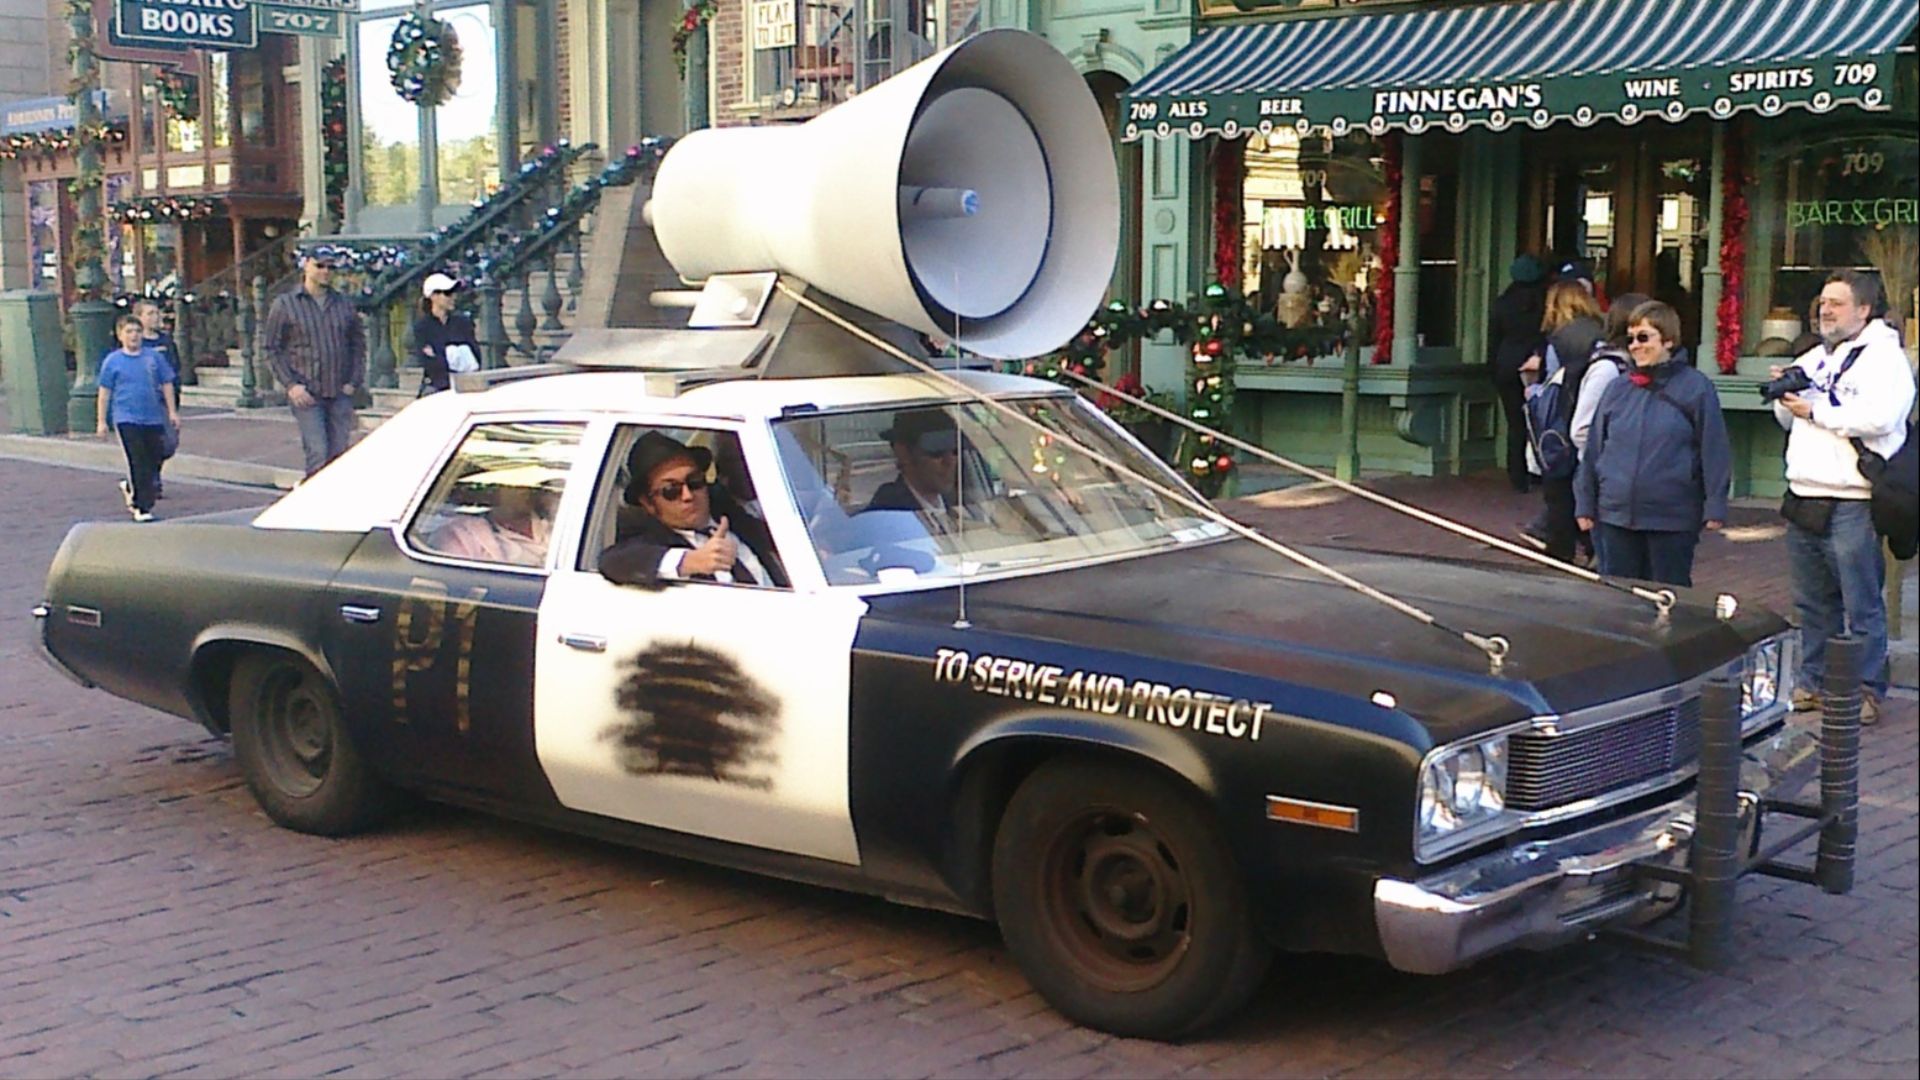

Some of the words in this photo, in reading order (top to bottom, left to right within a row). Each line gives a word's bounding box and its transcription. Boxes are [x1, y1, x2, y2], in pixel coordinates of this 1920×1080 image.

[141, 8, 234, 37] BOOKS
[271, 11, 331, 30] 707
[758, 2, 790, 24] FLAT
[757, 27, 770, 45] TO
[774, 24, 793, 43] LET
[1130, 103, 1157, 120] 709
[1168, 101, 1208, 117] ALES
[1260, 98, 1303, 115] BEER
[1374, 84, 1542, 114] FINNEGAN'S
[1625, 78, 1681, 98] WINE
[1729, 68, 1814, 92] SPIRITS
[1834, 63, 1877, 86] 709
[1842, 152, 1884, 176] 709
[1786, 200, 1842, 227] BAR
[1851, 199, 1868, 225] &
[935, 648, 970, 683] TO
[971, 655, 1064, 704] SERVE
[1061, 671, 1125, 714] AND
[1127, 680, 1273, 741] PROTECT
